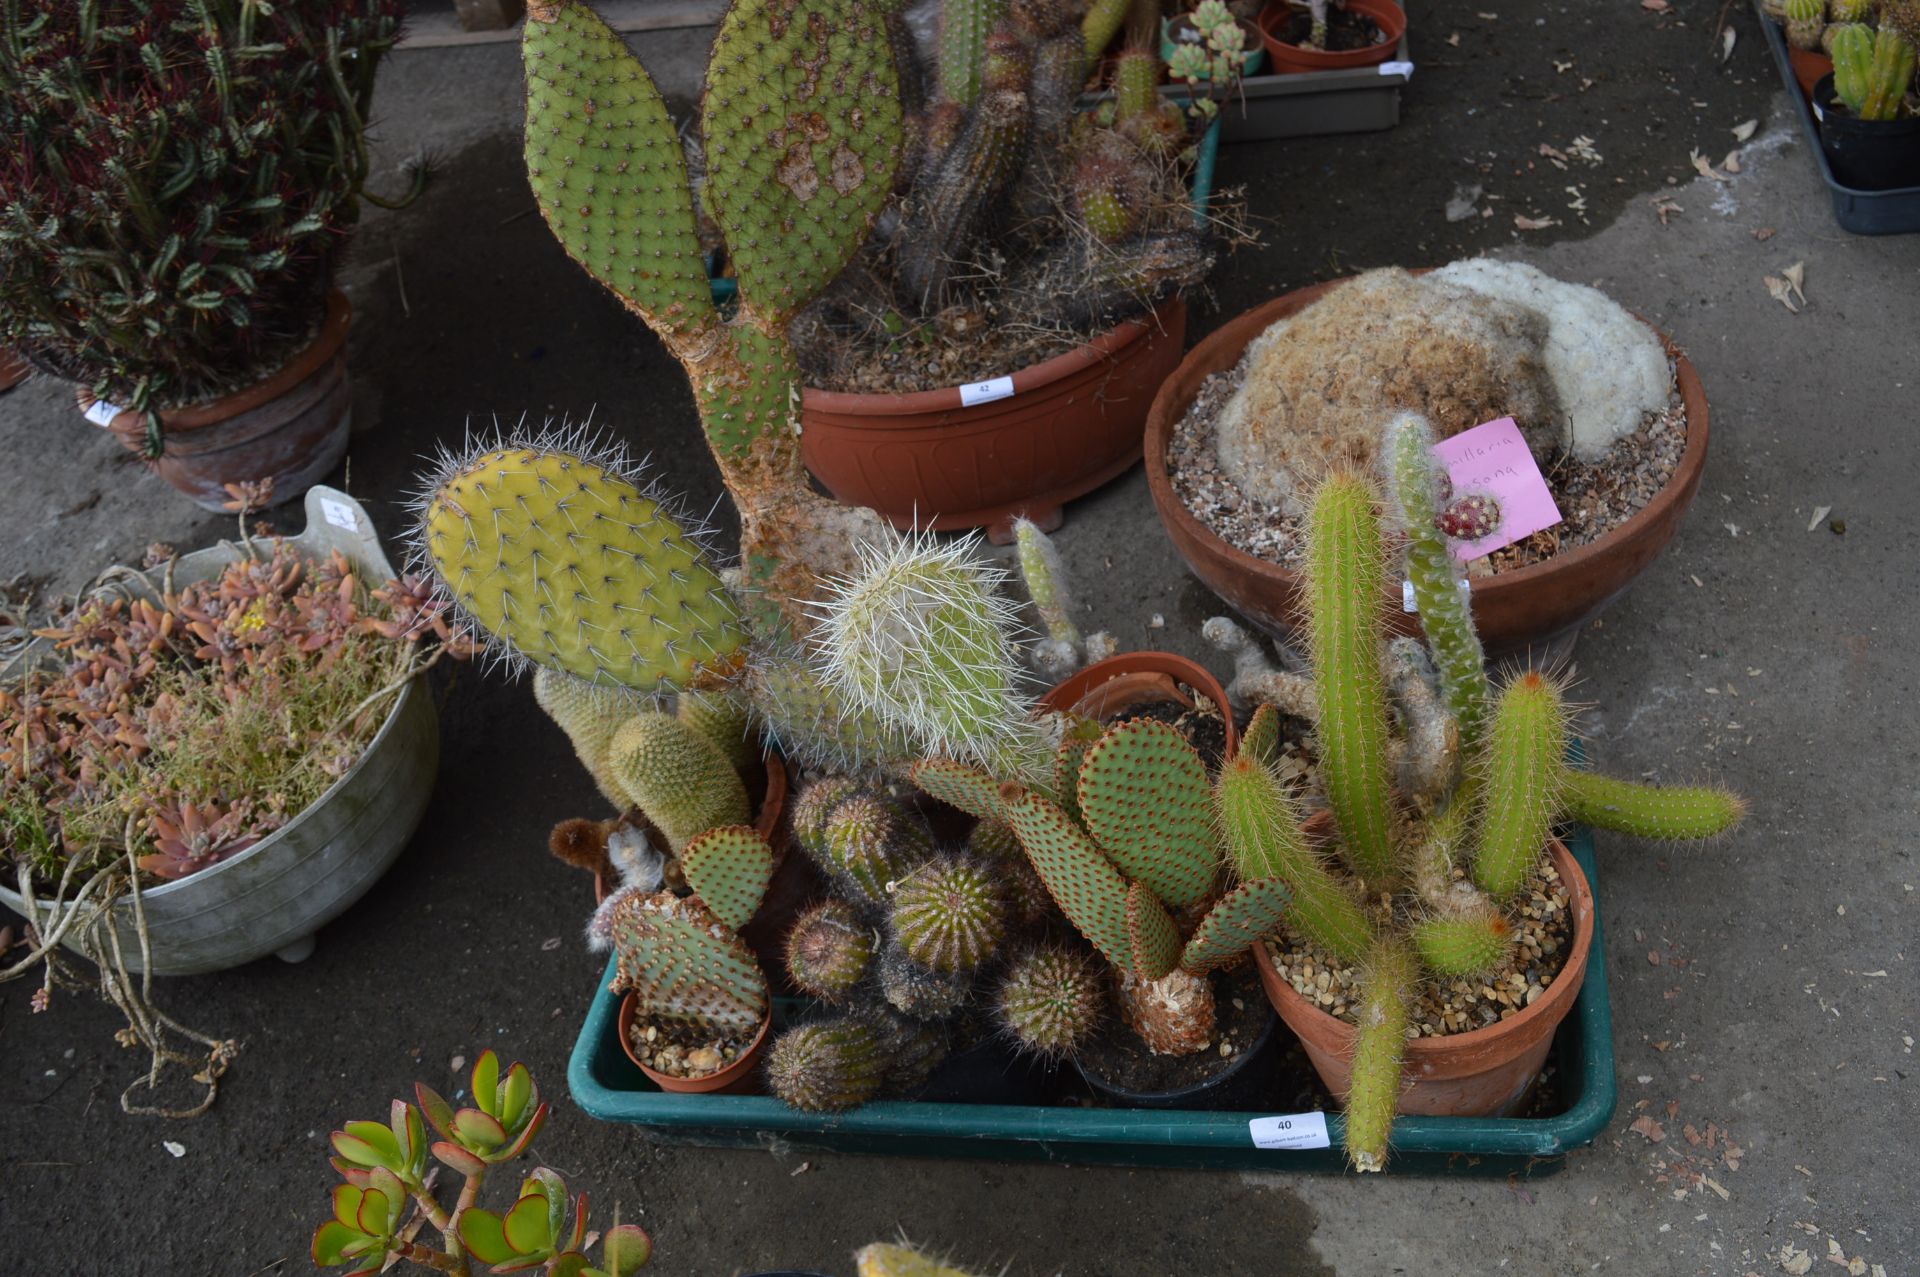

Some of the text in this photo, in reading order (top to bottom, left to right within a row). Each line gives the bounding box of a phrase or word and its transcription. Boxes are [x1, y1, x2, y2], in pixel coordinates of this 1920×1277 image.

[979, 384, 990, 392] 42
[1446, 438, 1513, 466] millaria
[1278, 1120, 1292, 1130] 40
